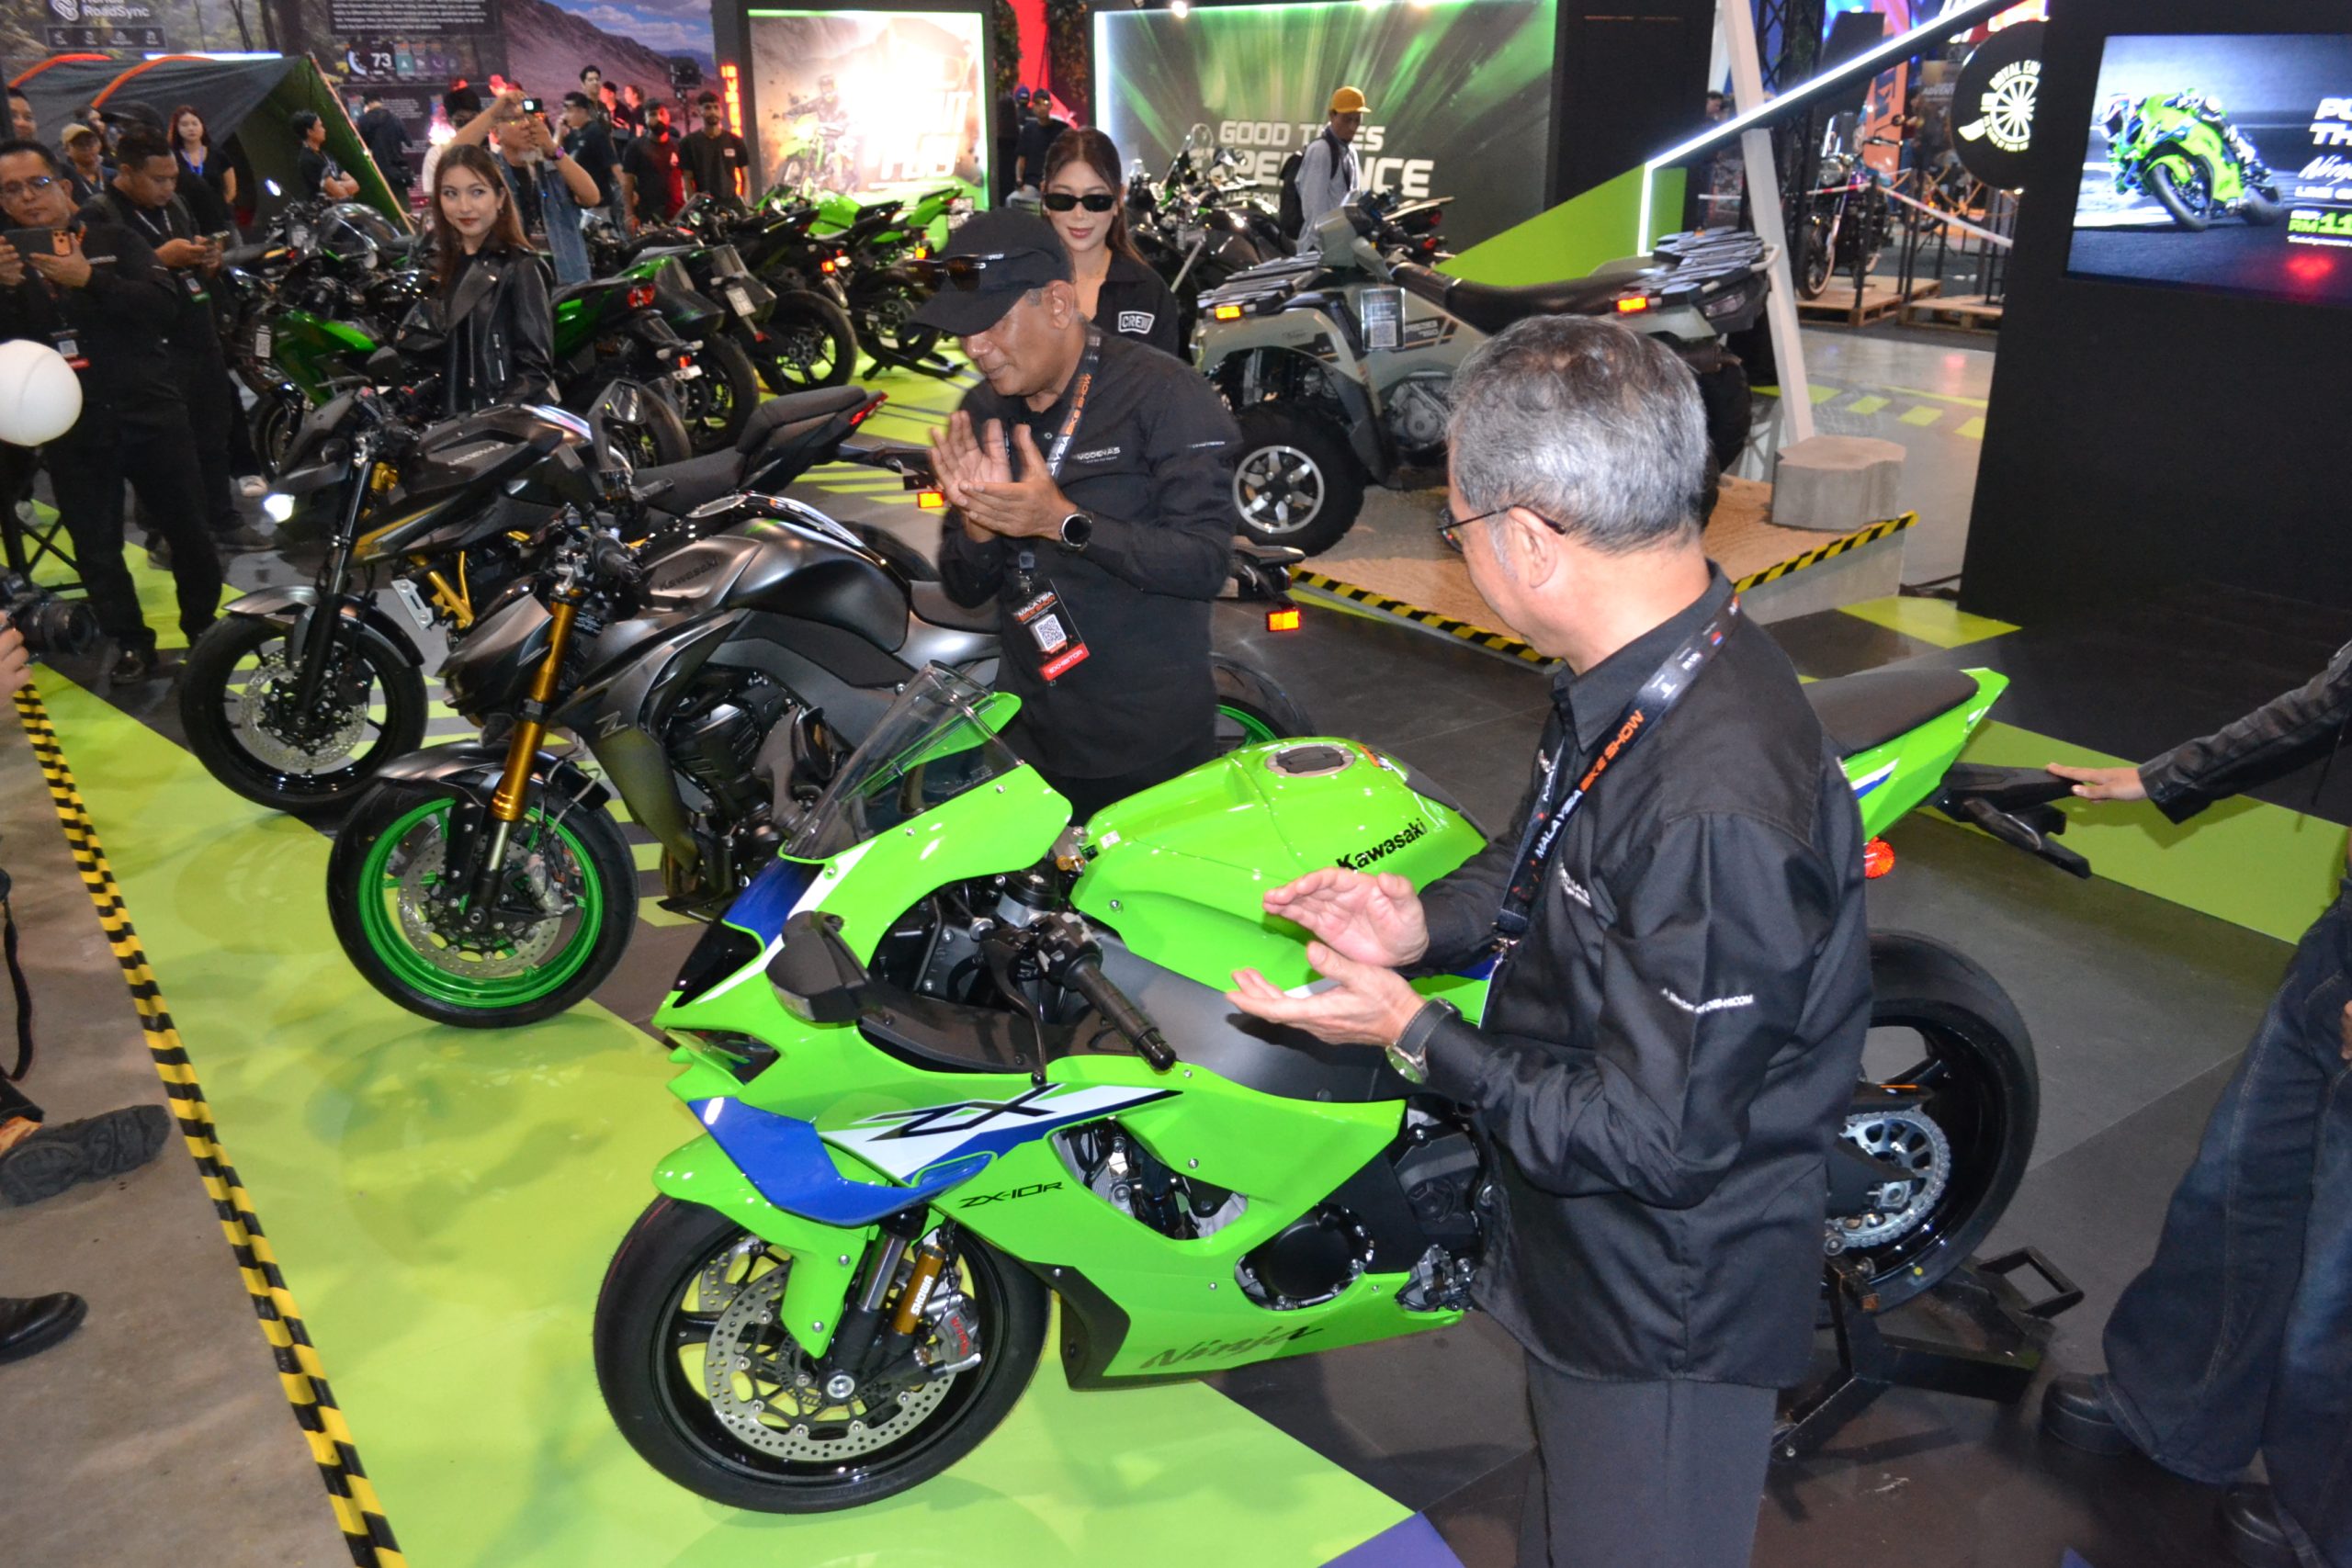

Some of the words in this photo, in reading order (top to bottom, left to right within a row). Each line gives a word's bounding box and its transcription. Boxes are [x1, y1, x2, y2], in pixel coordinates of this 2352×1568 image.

[370, 52, 392, 68] 73
[1219, 120, 1290, 146] GOOD
[1298, 123, 1385, 152] TES
[1534, 788, 1584, 859] MALAYSIA
[1579, 756, 1607, 792] BIKE
[1605, 709, 1645, 761] SHOW
[1336, 817, 1428, 871] Kawasaki
[958, 1180, 1063, 1209] ZX-10R
[910, 1274, 934, 1315] SHOWA
[1139, 1325, 1324, 1370] Ninja
